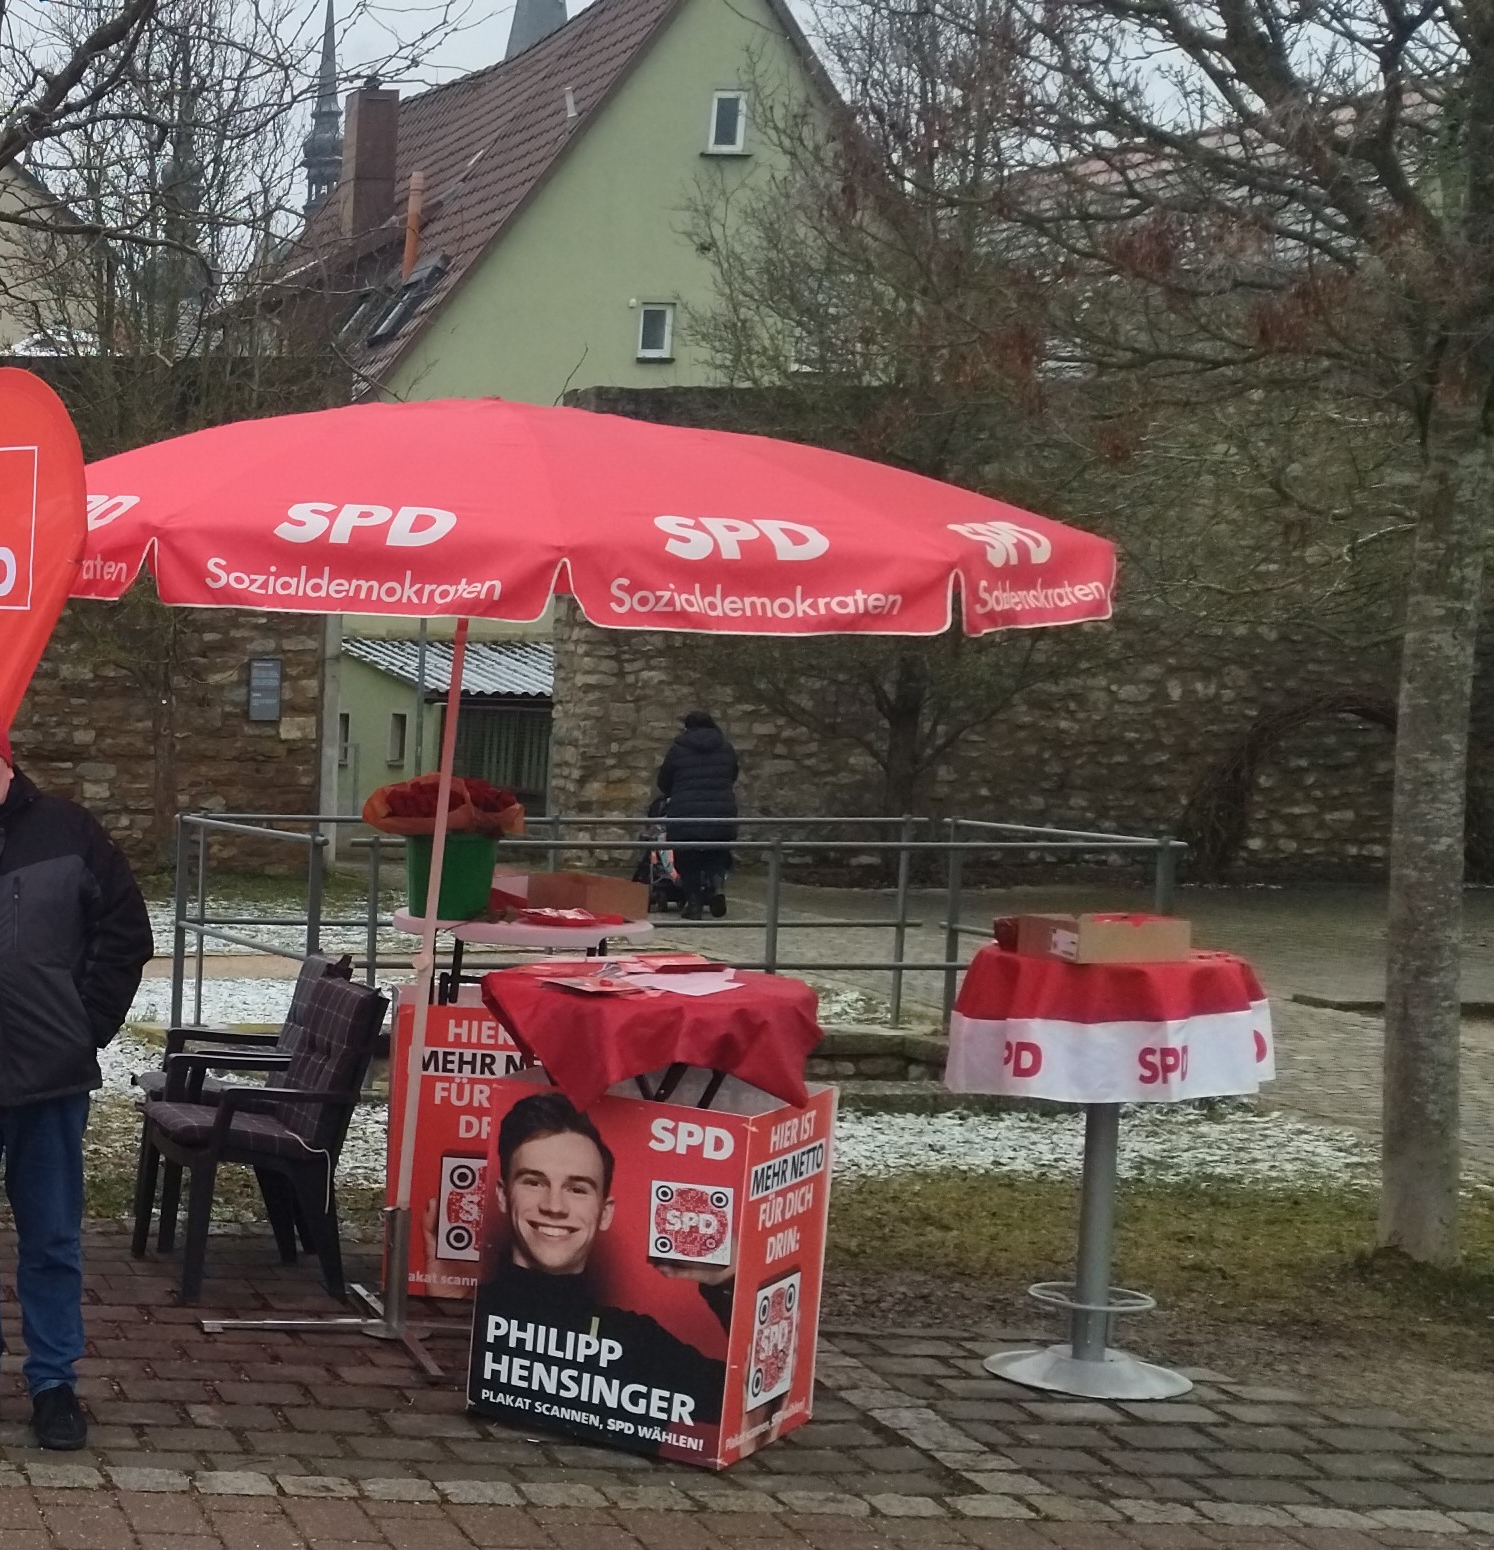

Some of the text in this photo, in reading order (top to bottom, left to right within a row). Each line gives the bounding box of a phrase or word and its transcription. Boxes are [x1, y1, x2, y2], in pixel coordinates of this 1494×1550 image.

[86, 494, 141, 532] PD
[273, 502, 458, 547] SPD
[653, 515, 830, 561] SPD
[947, 521, 1052, 568] SPD
[206, 557, 502, 605] Sozialdemokraten
[610, 577, 903, 619] Sozialdemokraten
[421, 1050, 497, 1076] MEHR
[434, 1076, 491, 1108] FÜR
[648, 1117, 735, 1161] SPD
[769, 1109, 817, 1154] HIER IST
[751, 1142, 824, 1198] MEHR NETTO
[665, 1209, 719, 1235] SPD
[758, 1182, 814, 1231] FÜR DICH
[765, 1225, 801, 1265] DRIN:
[486, 1314, 623, 1368] PHILIPP
[483, 1351, 695, 1427] HENSINGER
[481, 1388, 705, 1452] PLAKAT SCANNEN, SPD WÄHLEN!
